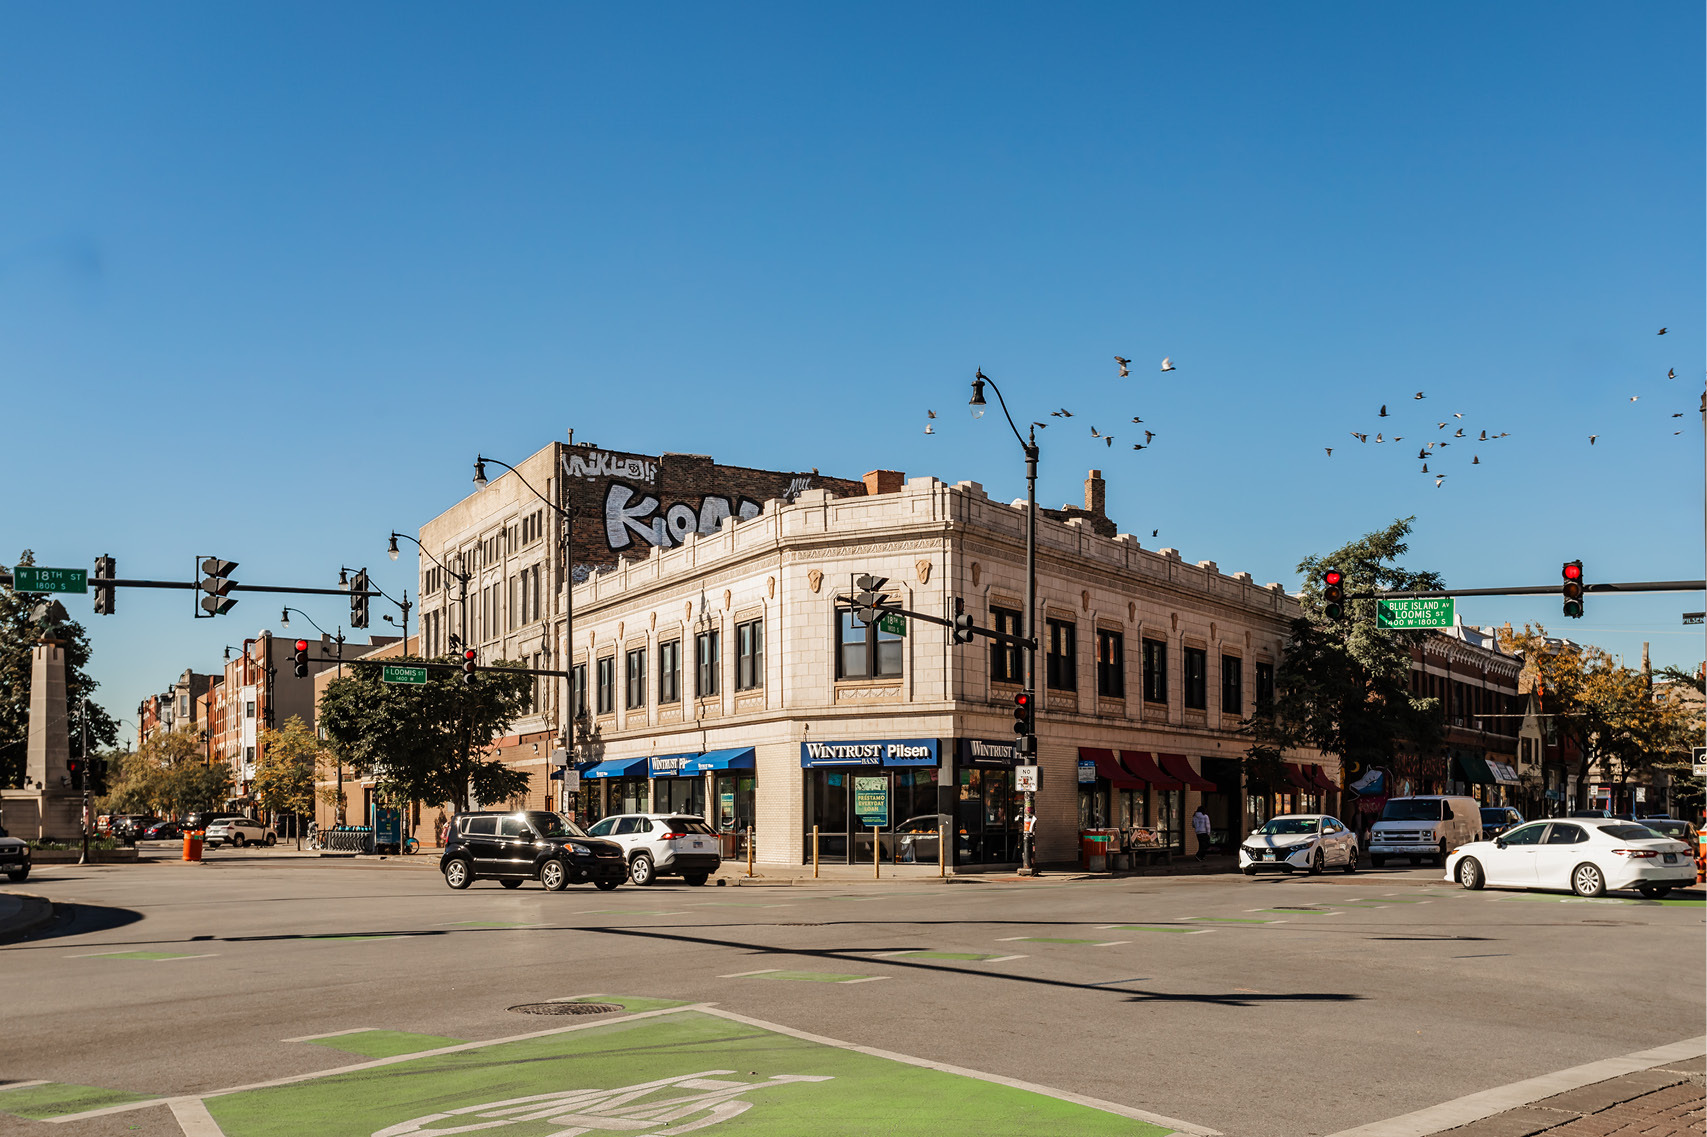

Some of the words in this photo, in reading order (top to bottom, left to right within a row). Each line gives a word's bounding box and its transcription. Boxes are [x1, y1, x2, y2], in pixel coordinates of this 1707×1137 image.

[36, 570, 62, 580] 18TH
[1389, 602, 1408, 610] BLUE
[1412, 602, 1439, 610] ISLAND
[887, 744, 929, 757] Pilsen
